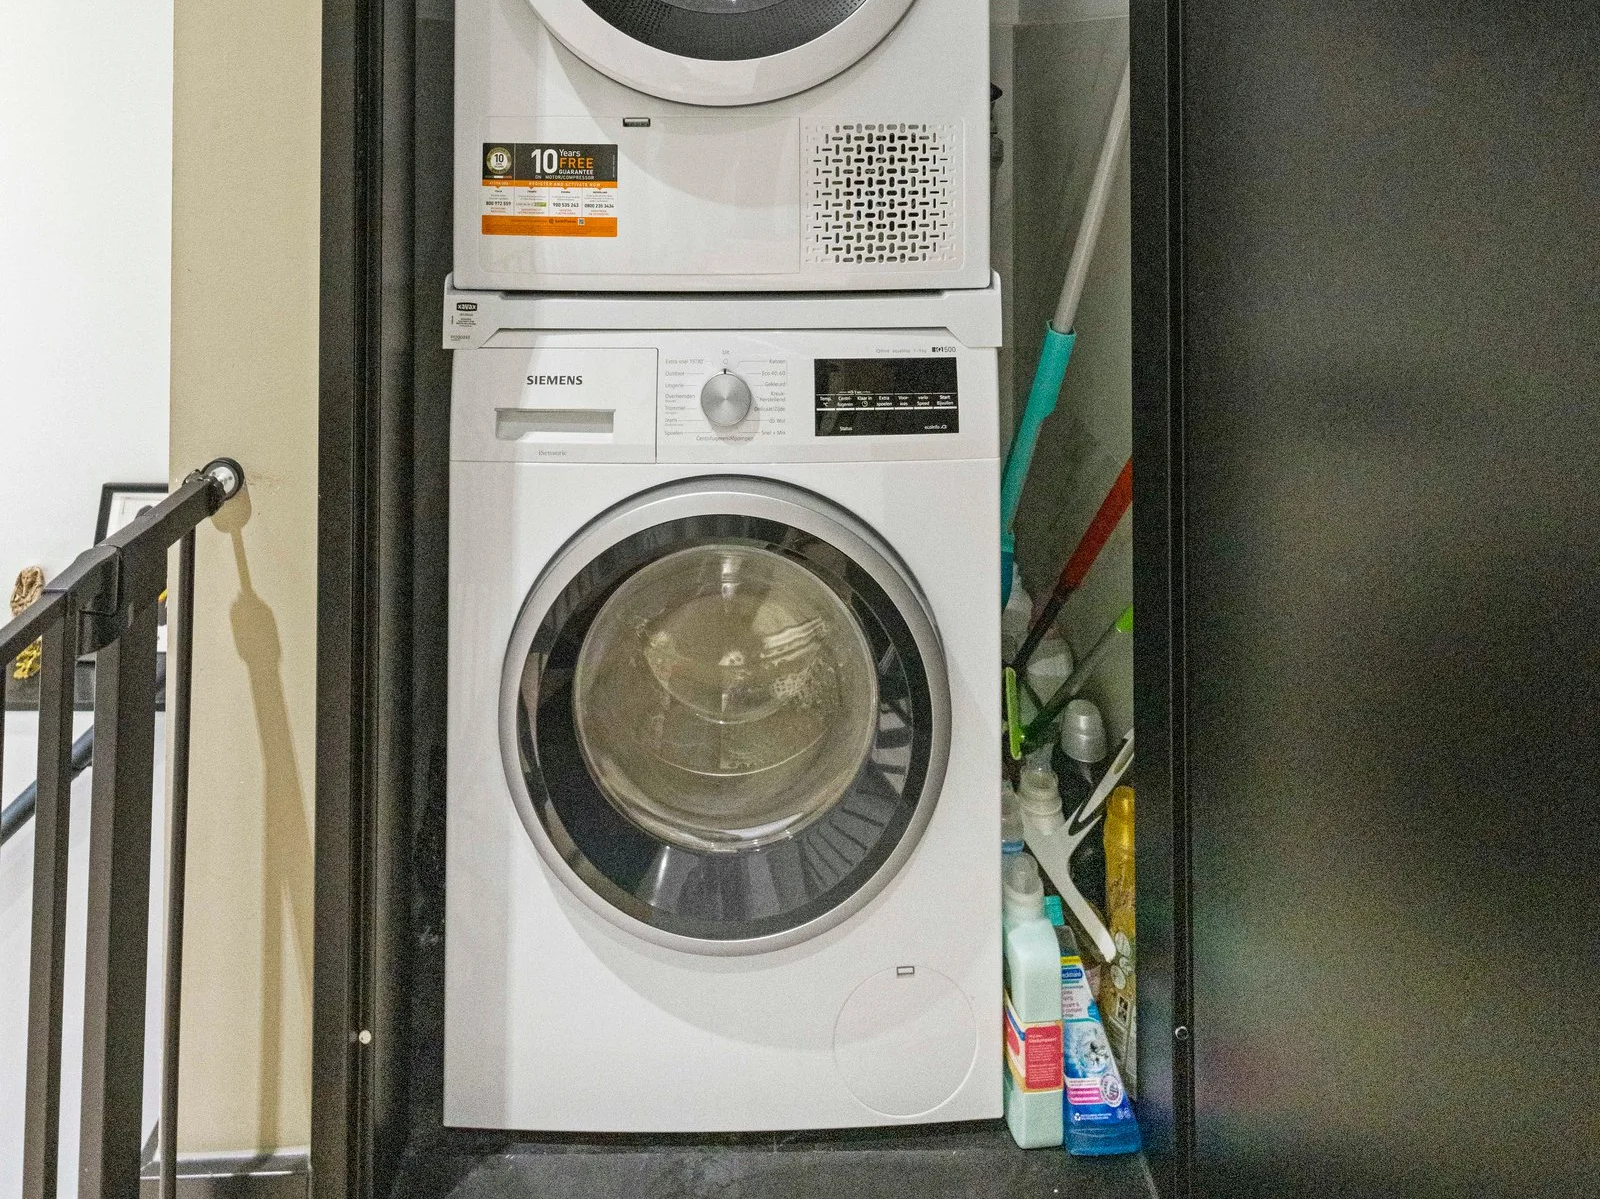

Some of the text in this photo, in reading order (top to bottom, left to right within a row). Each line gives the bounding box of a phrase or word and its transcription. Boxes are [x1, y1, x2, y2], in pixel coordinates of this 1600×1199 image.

[494, 153, 504, 163] 10
[559, 148, 581, 157] Years
[531, 148, 558, 174] 10
[560, 157, 594, 169] FREE
[526, 375, 583, 386] SIEMENS
